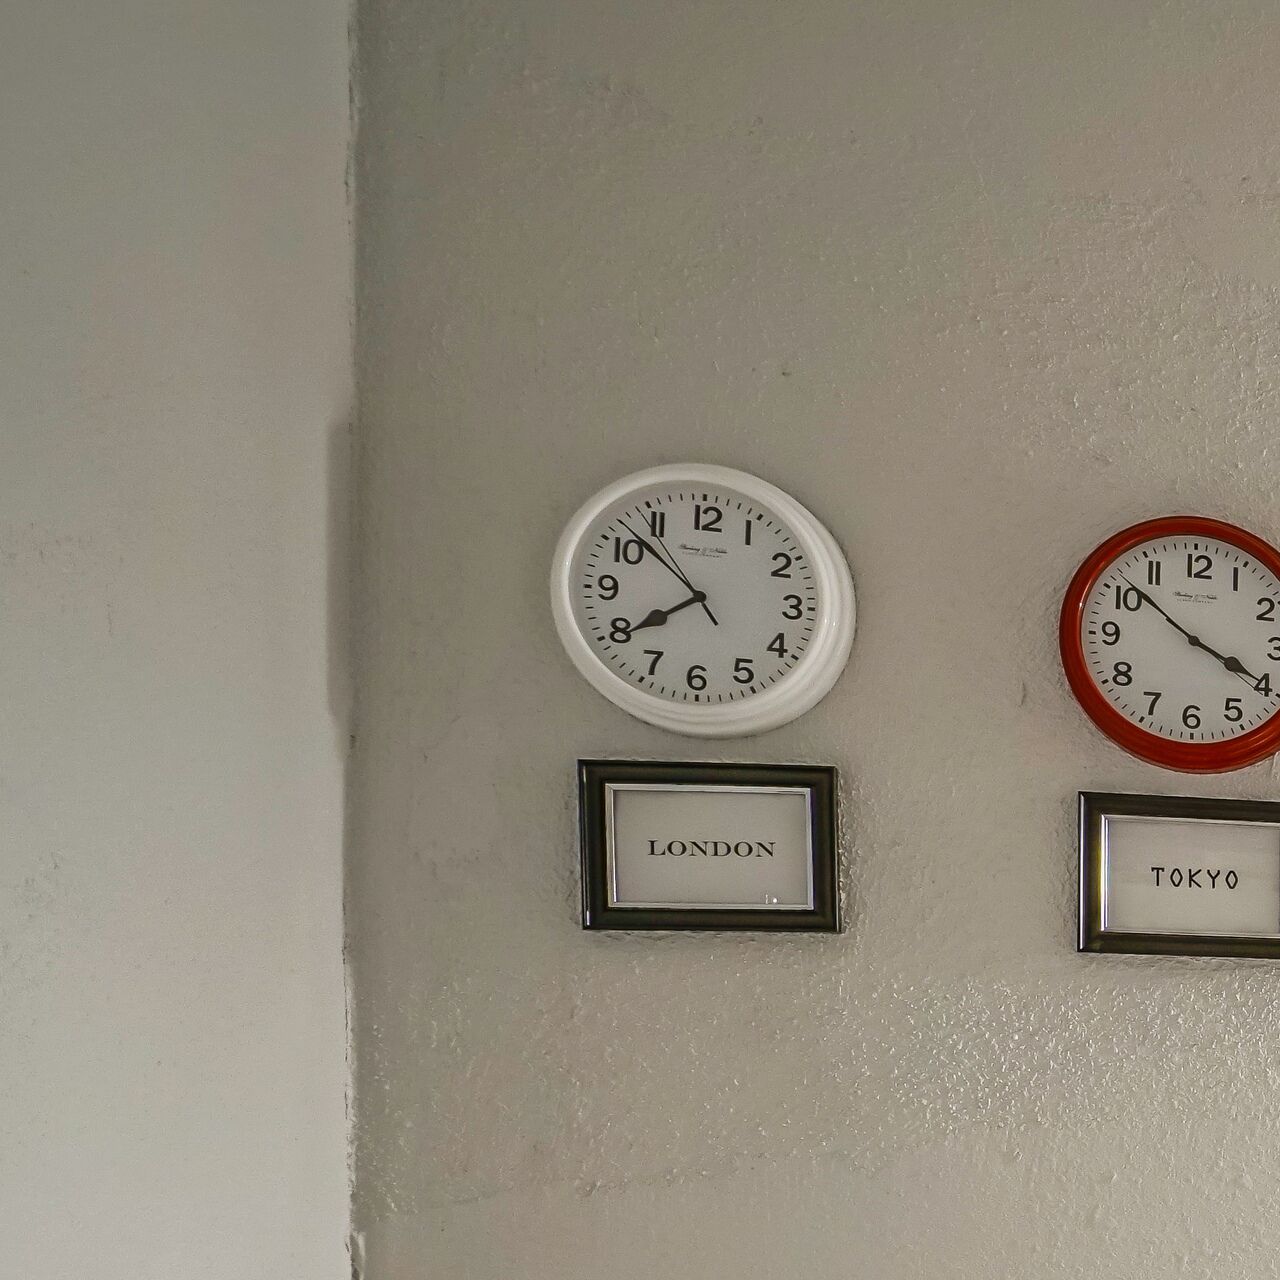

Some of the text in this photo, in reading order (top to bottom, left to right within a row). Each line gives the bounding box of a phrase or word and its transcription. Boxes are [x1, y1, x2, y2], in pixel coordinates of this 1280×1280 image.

[651, 511, 665, 538] 11
[694, 504, 723, 533] 12
[745, 519, 752, 546] 1
[614, 537, 644, 565] 10
[771, 552, 792, 579] 2
[1148, 560, 1161, 585] 11
[1187, 554, 1212, 580] 12
[597, 574, 619, 601] 9
[1233, 567, 1239, 591] 1
[782, 594, 803, 620] 3
[1116, 585, 1143, 611] 10
[1256, 597, 1275, 622] 2
[609, 617, 632, 643] 8
[1101, 621, 1120, 646] 9
[766, 632, 788, 658] 4
[643, 650, 664, 675] 7
[732, 658, 754, 684] 5
[1112, 662, 1133, 686] 8
[686, 665, 707, 691] 6
[1254, 673, 1272, 696] 4
[1143, 691, 1162, 715] 7
[1223, 698, 1243, 722] 5
[1182, 705, 1201, 729] 6
[647, 839, 776, 858] LONDON
[1151, 867, 1239, 889] TOKYO
